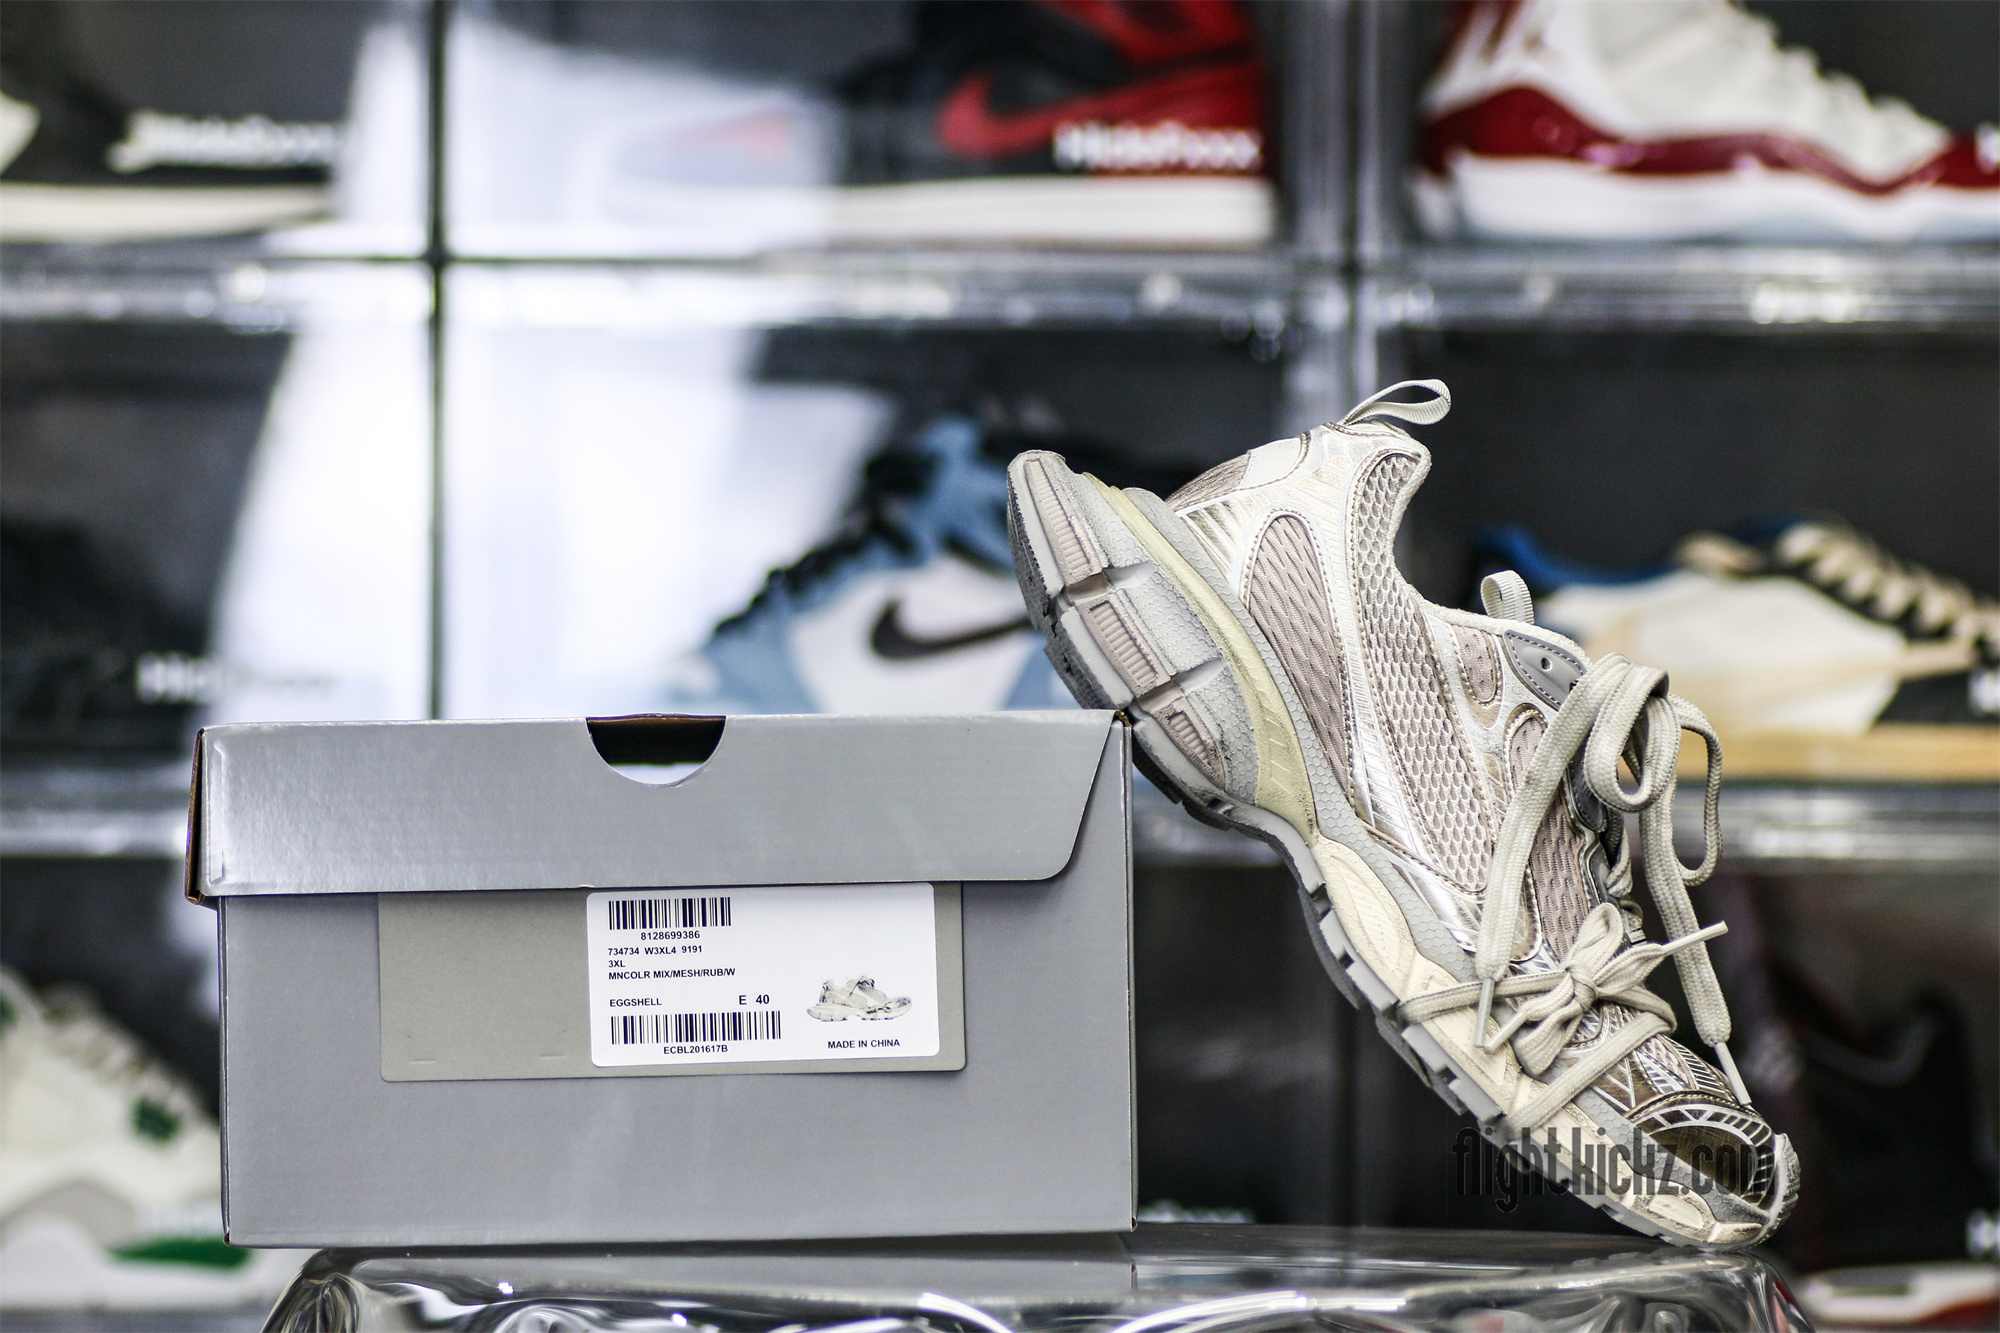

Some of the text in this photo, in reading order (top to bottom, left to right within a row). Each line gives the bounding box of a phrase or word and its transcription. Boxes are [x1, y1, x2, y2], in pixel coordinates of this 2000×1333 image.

[640, 930, 701, 941] 8128699386
[607, 945, 703, 956] 734734 W3XL4 9191
[608, 959, 626, 968] 3XL
[608, 968, 736, 980] MNCOLR MIX/MESH/RUB/W
[609, 998, 662, 1007] EGGSHELL
[738, 994, 770, 1005] E 40
[663, 1044, 728, 1054] ECBL201617B
[827, 1038, 900, 1049] MADE IN CHINA
